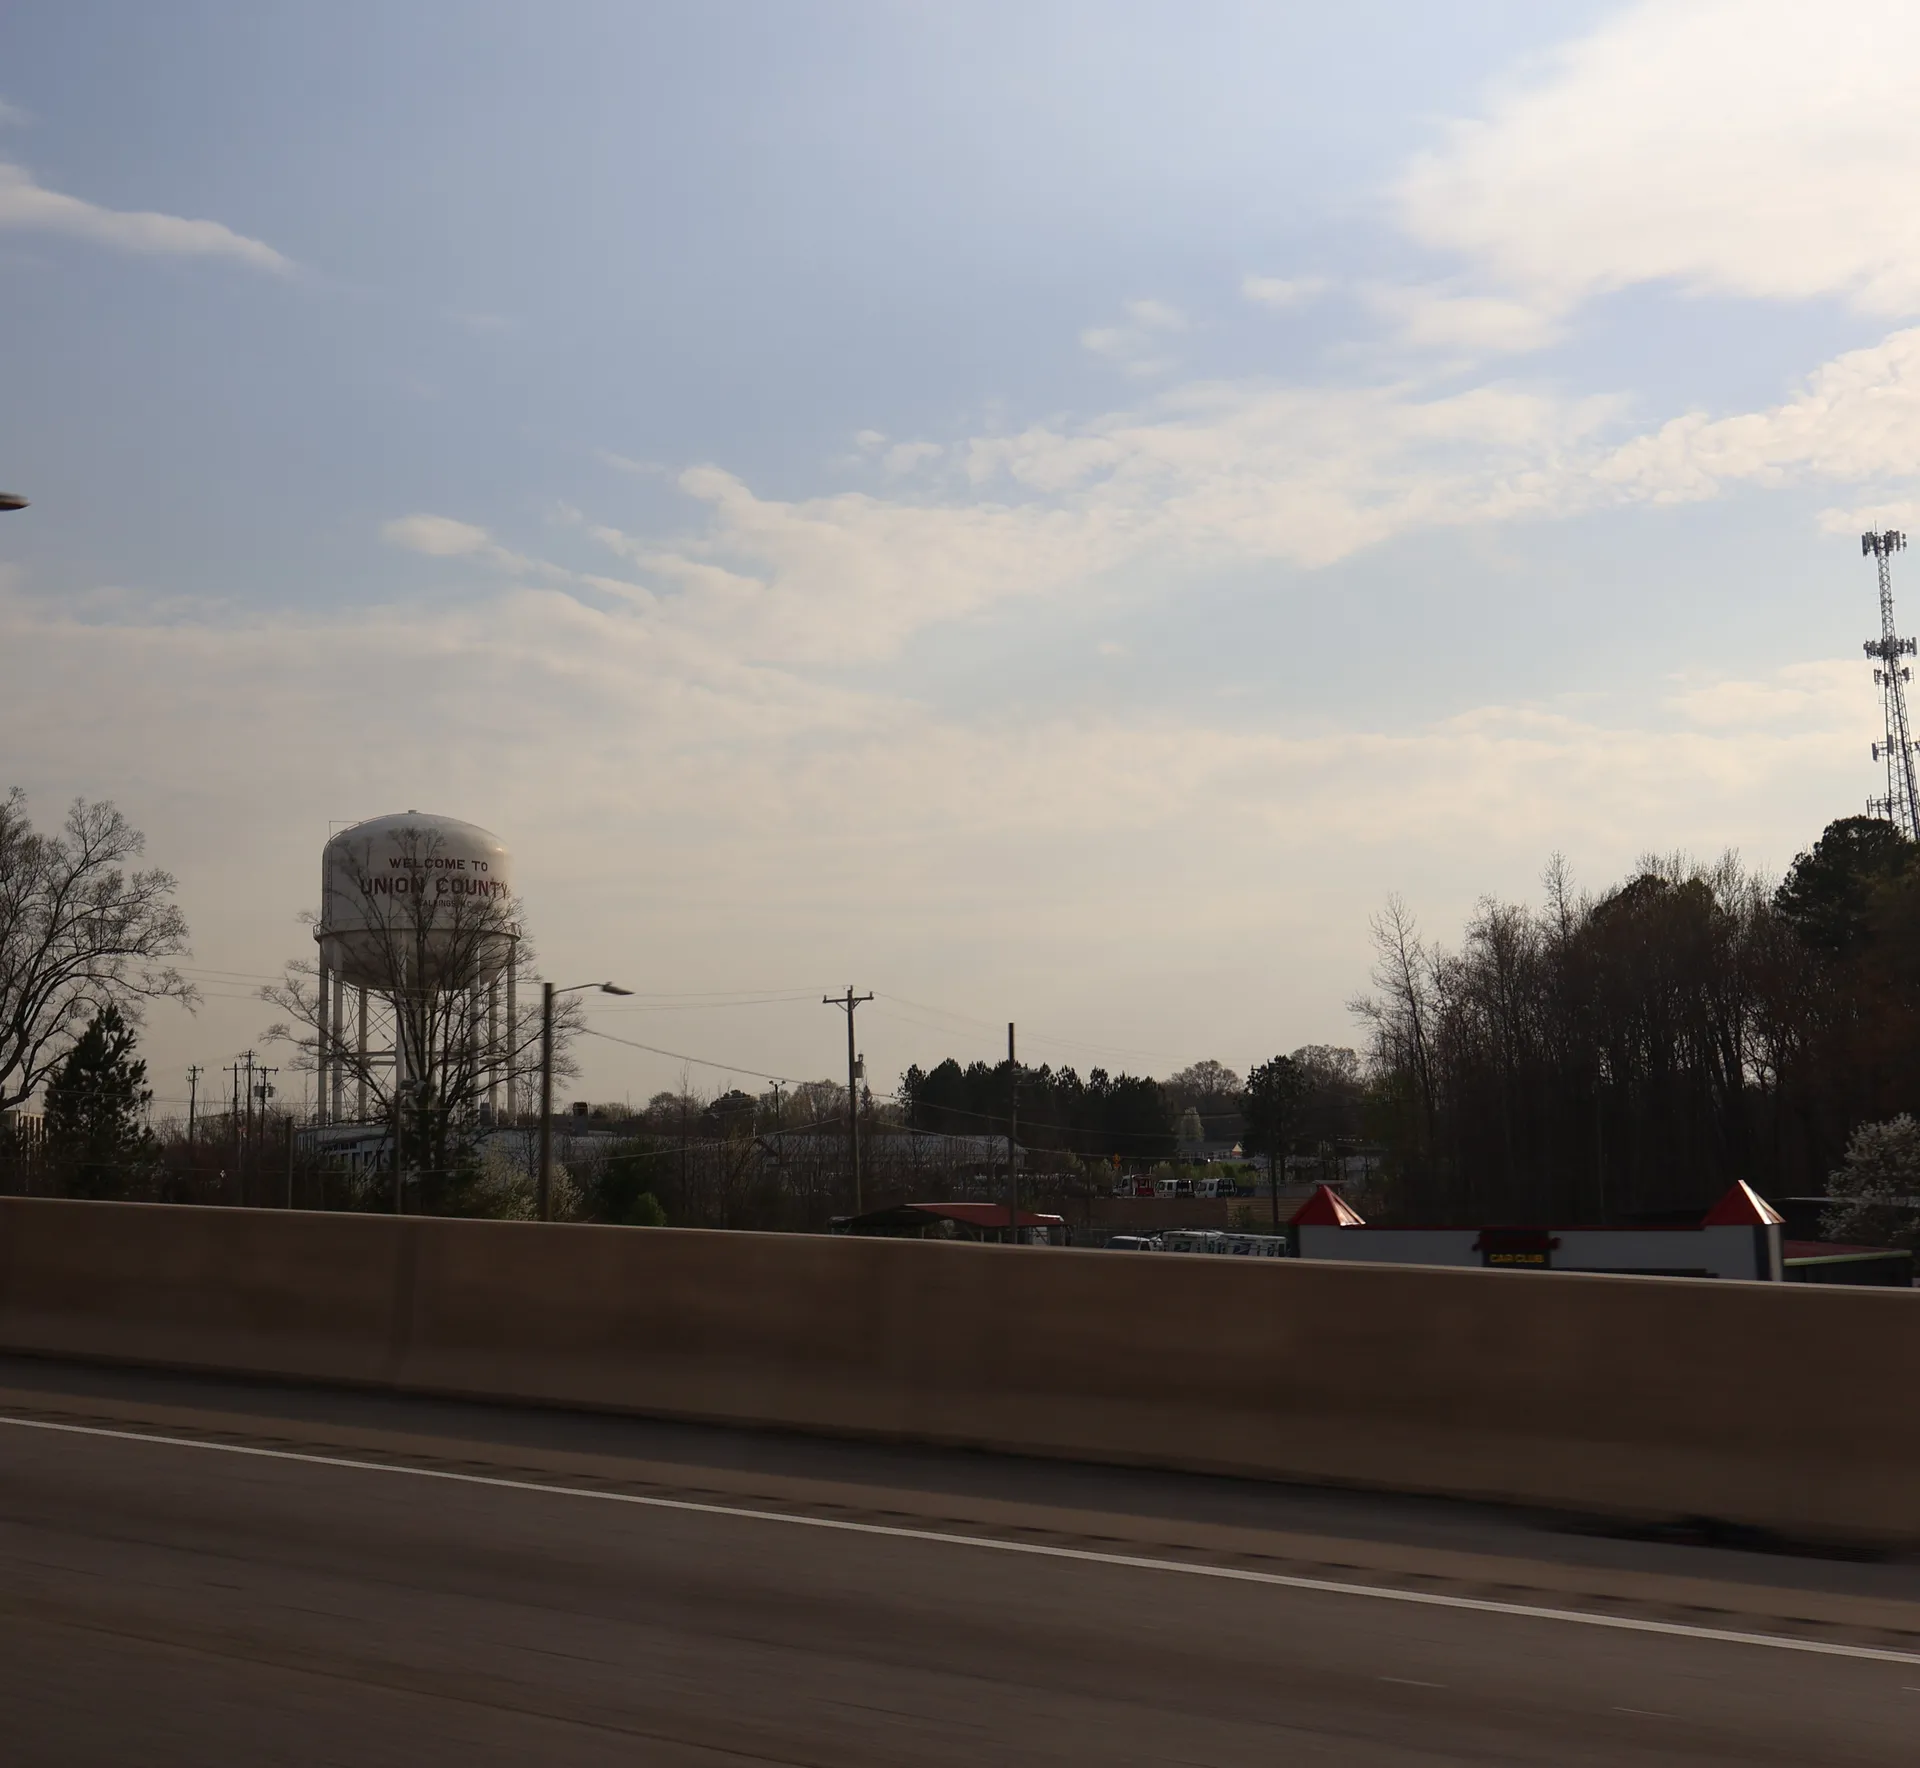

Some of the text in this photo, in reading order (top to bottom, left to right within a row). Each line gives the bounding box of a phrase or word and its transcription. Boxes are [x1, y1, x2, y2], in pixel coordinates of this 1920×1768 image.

[389, 858, 489, 872] WELCOME TO
[360, 877, 508, 900] UNION COUNTY
[1490, 1254, 1545, 1263] CAR CLUB
